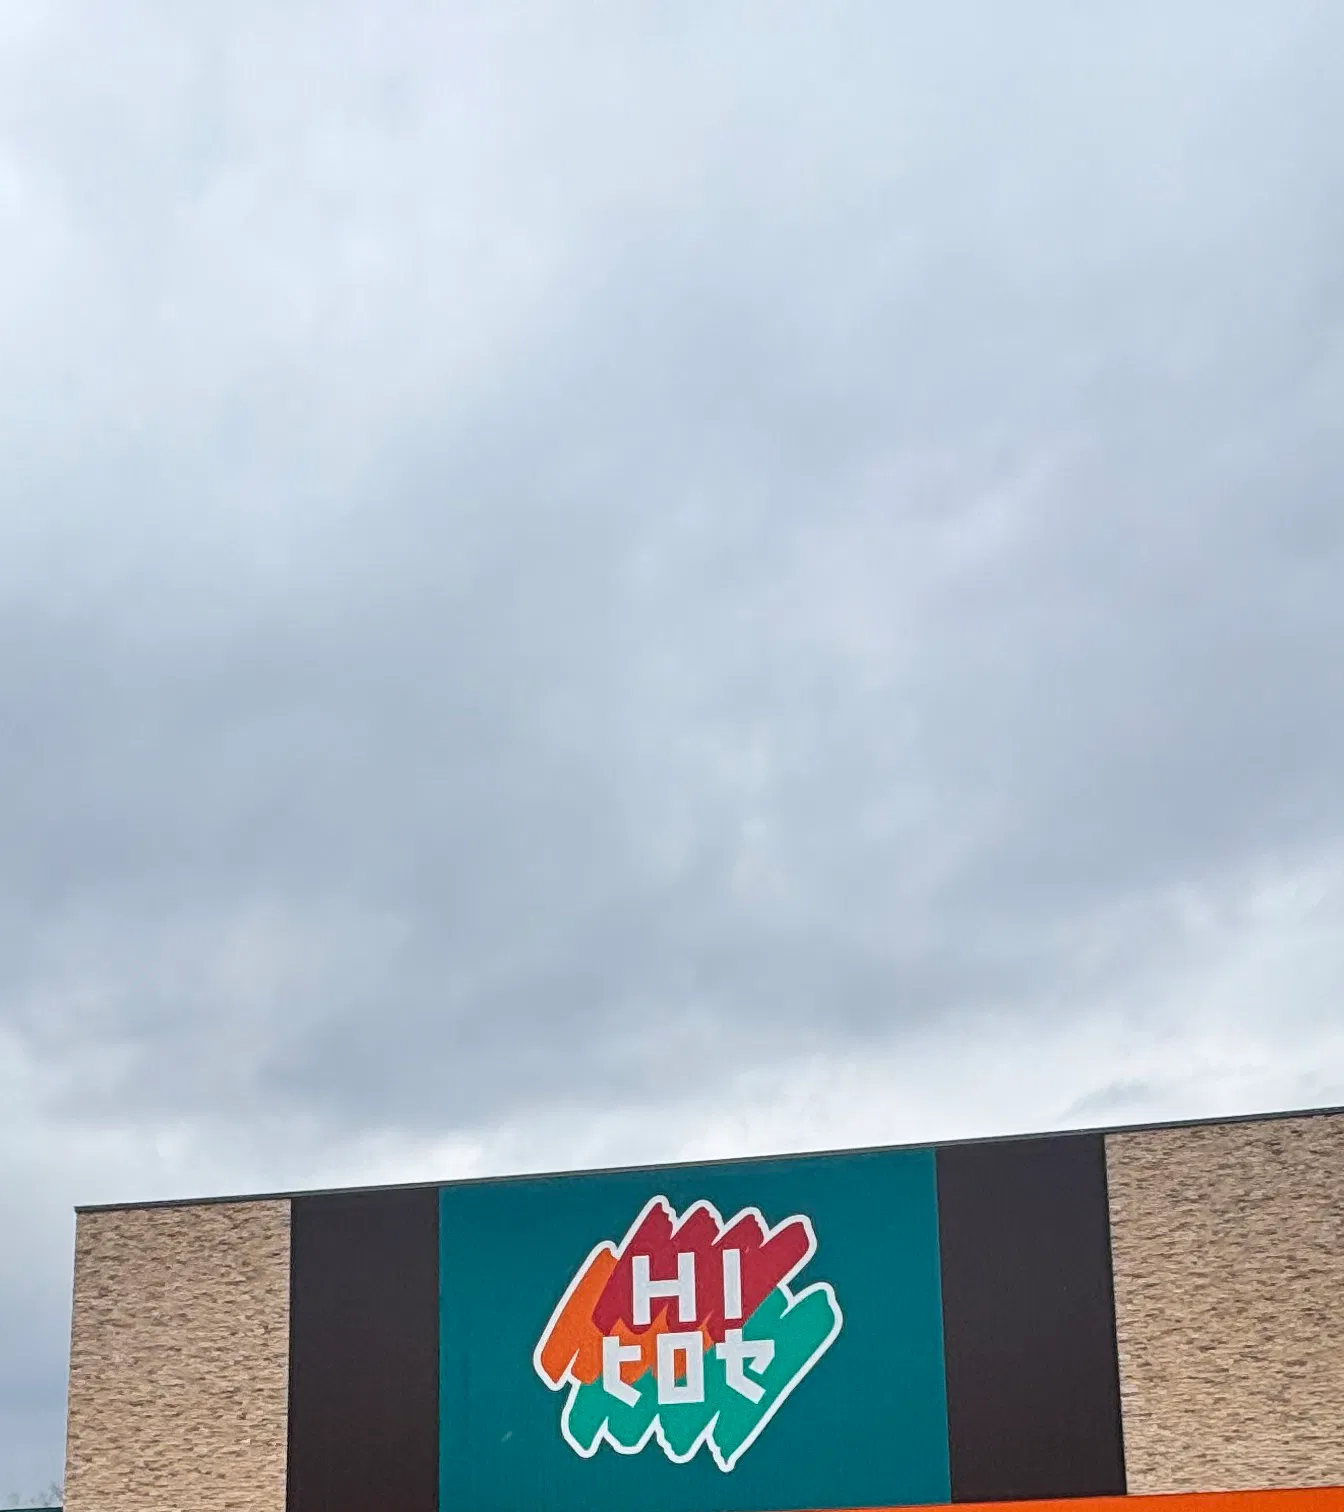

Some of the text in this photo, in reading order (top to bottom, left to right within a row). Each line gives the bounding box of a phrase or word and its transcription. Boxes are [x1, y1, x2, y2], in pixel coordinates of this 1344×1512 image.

[632, 1249, 742, 1325] HI
[603, 1329, 775, 1407] ヒロセ
